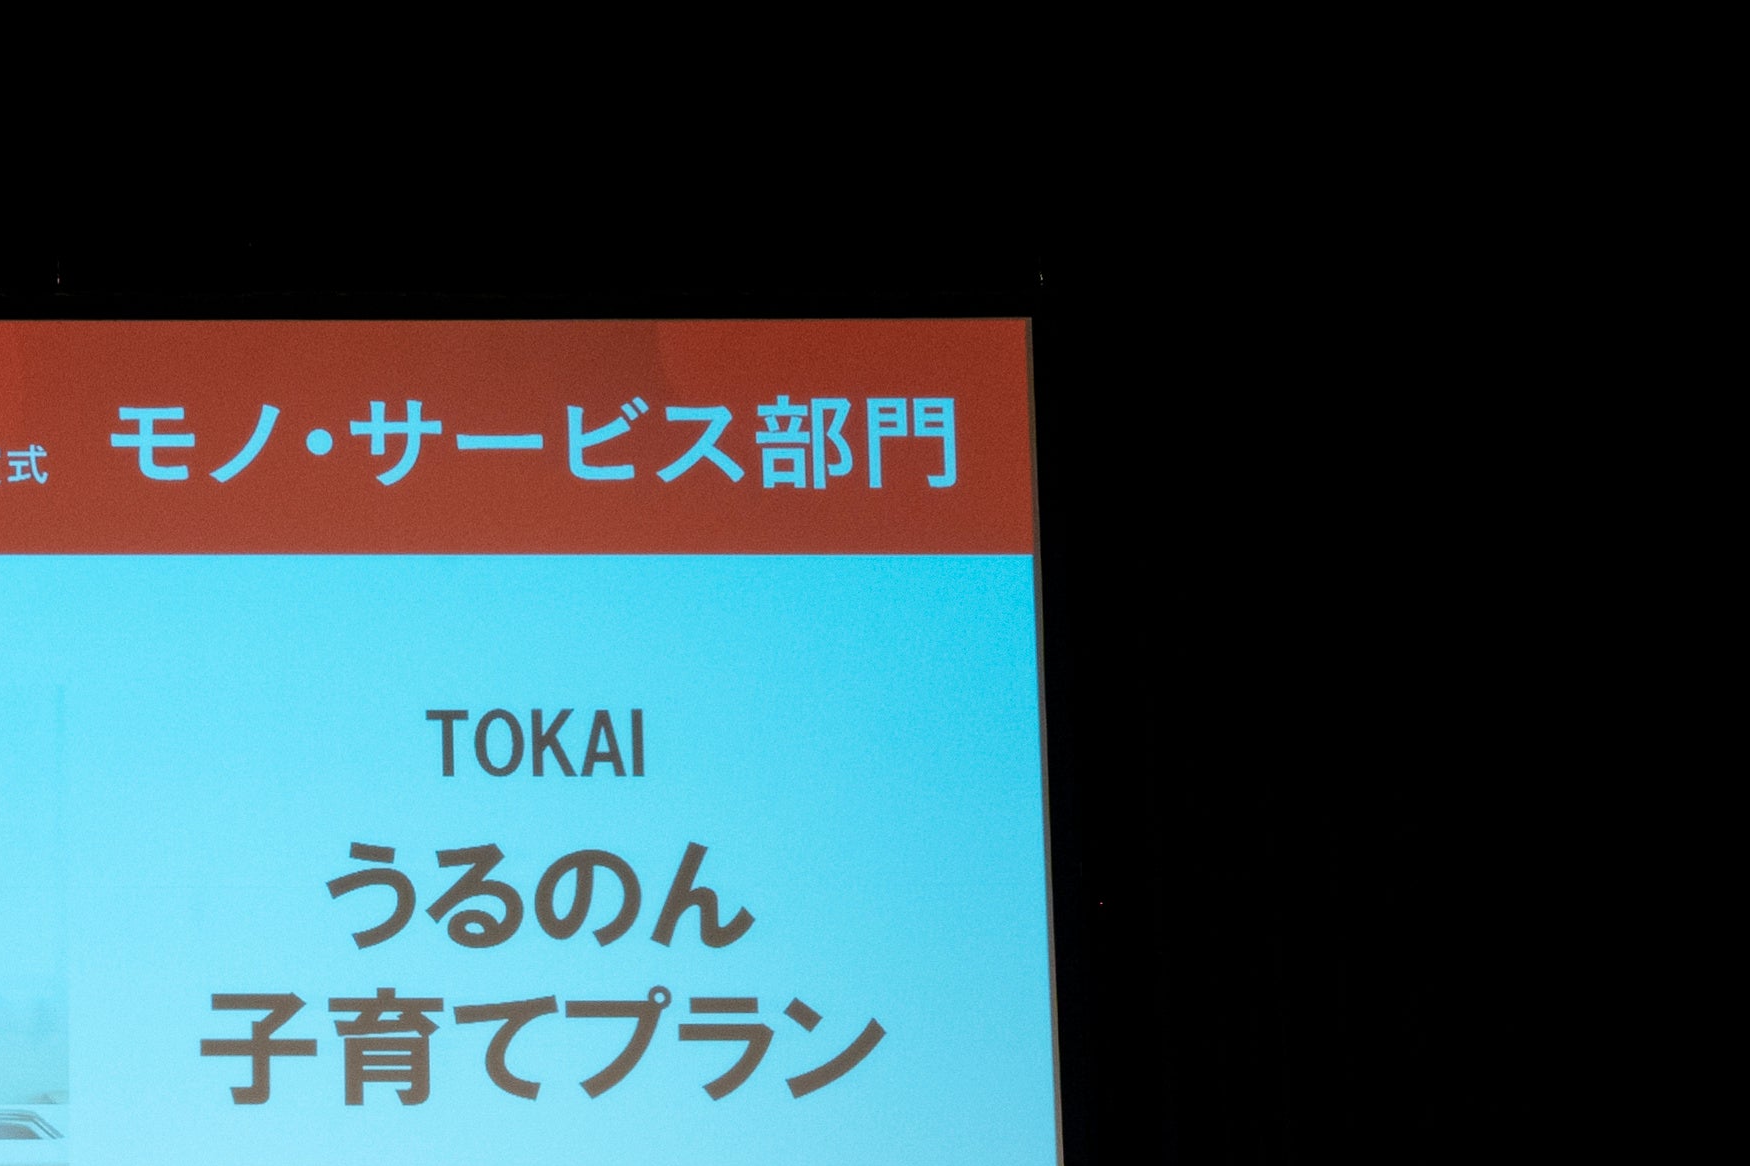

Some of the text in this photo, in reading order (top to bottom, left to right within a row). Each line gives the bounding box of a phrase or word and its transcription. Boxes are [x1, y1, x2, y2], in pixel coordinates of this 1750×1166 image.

[110, 396, 958, 489] モノ・サービス部門
[426, 708, 646, 777] TOKAI
[326, 841, 756, 950] うるのん
[199, 985, 888, 1106] 子育てプラン
